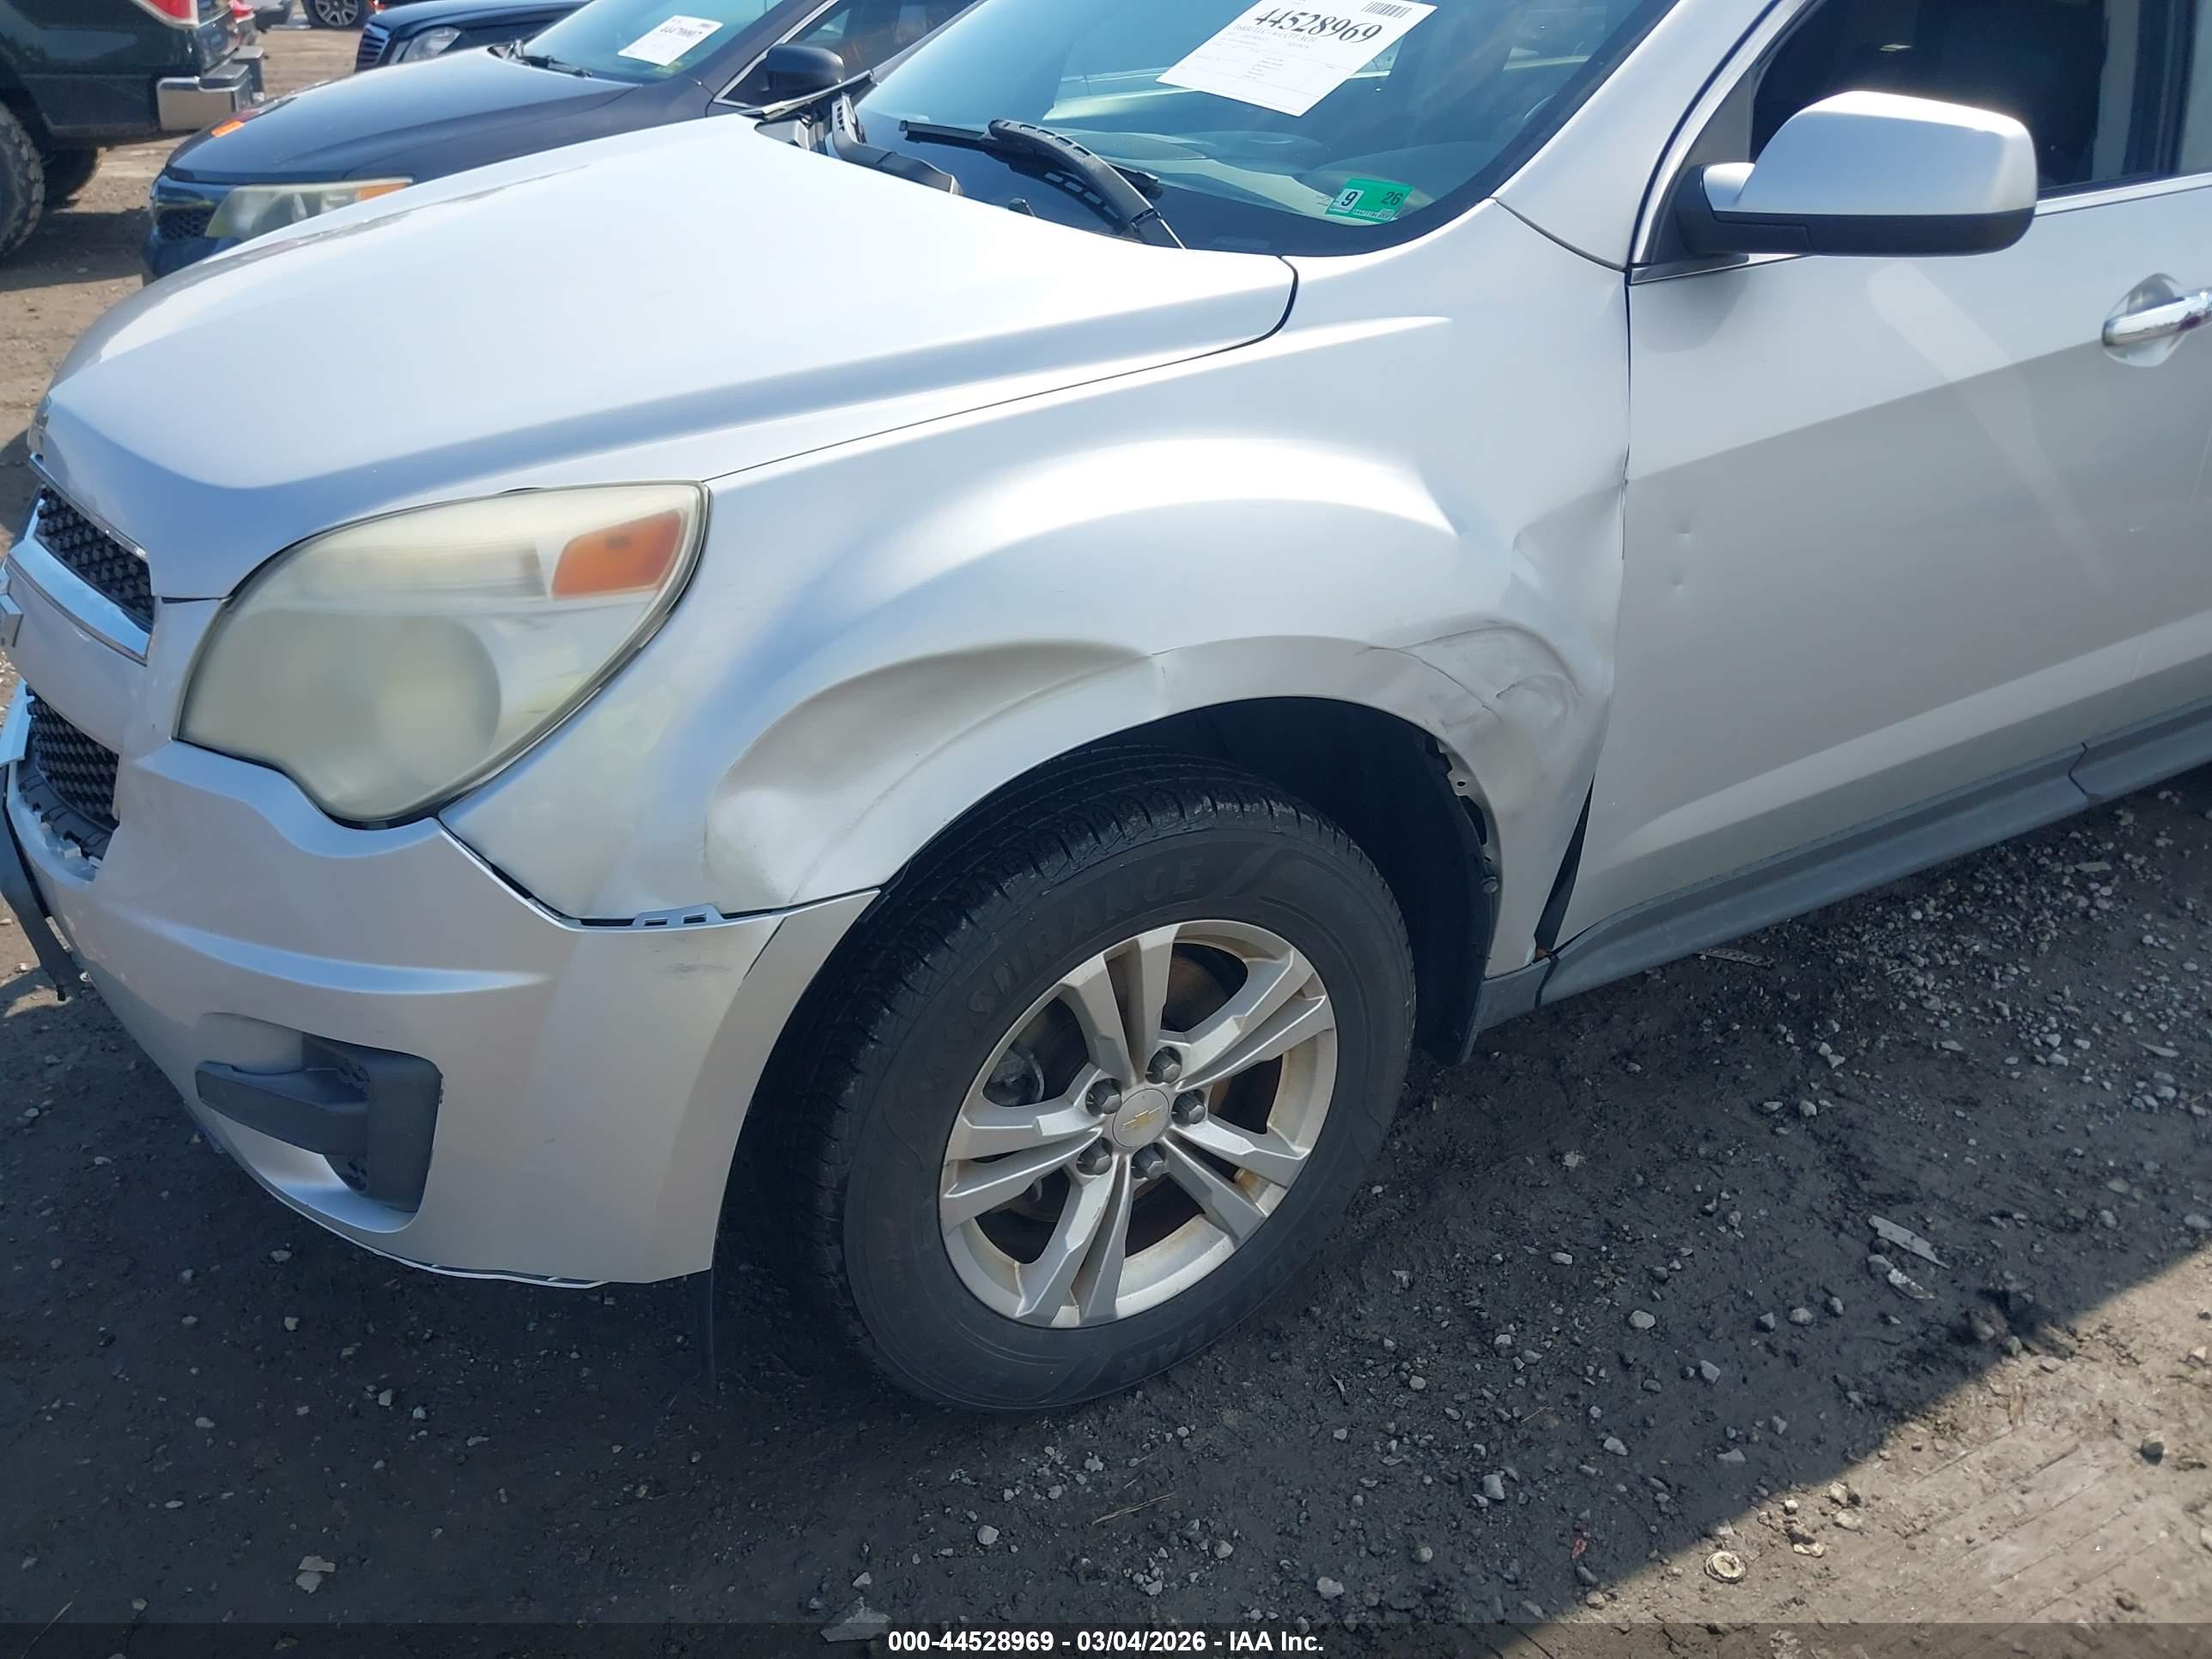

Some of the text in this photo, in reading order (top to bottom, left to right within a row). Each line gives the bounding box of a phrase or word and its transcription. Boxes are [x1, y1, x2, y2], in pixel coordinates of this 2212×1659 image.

[1255, 8, 1382, 43] 44528969
[1340, 191, 1358, 207] 9
[1381, 191, 1403, 206] 26
